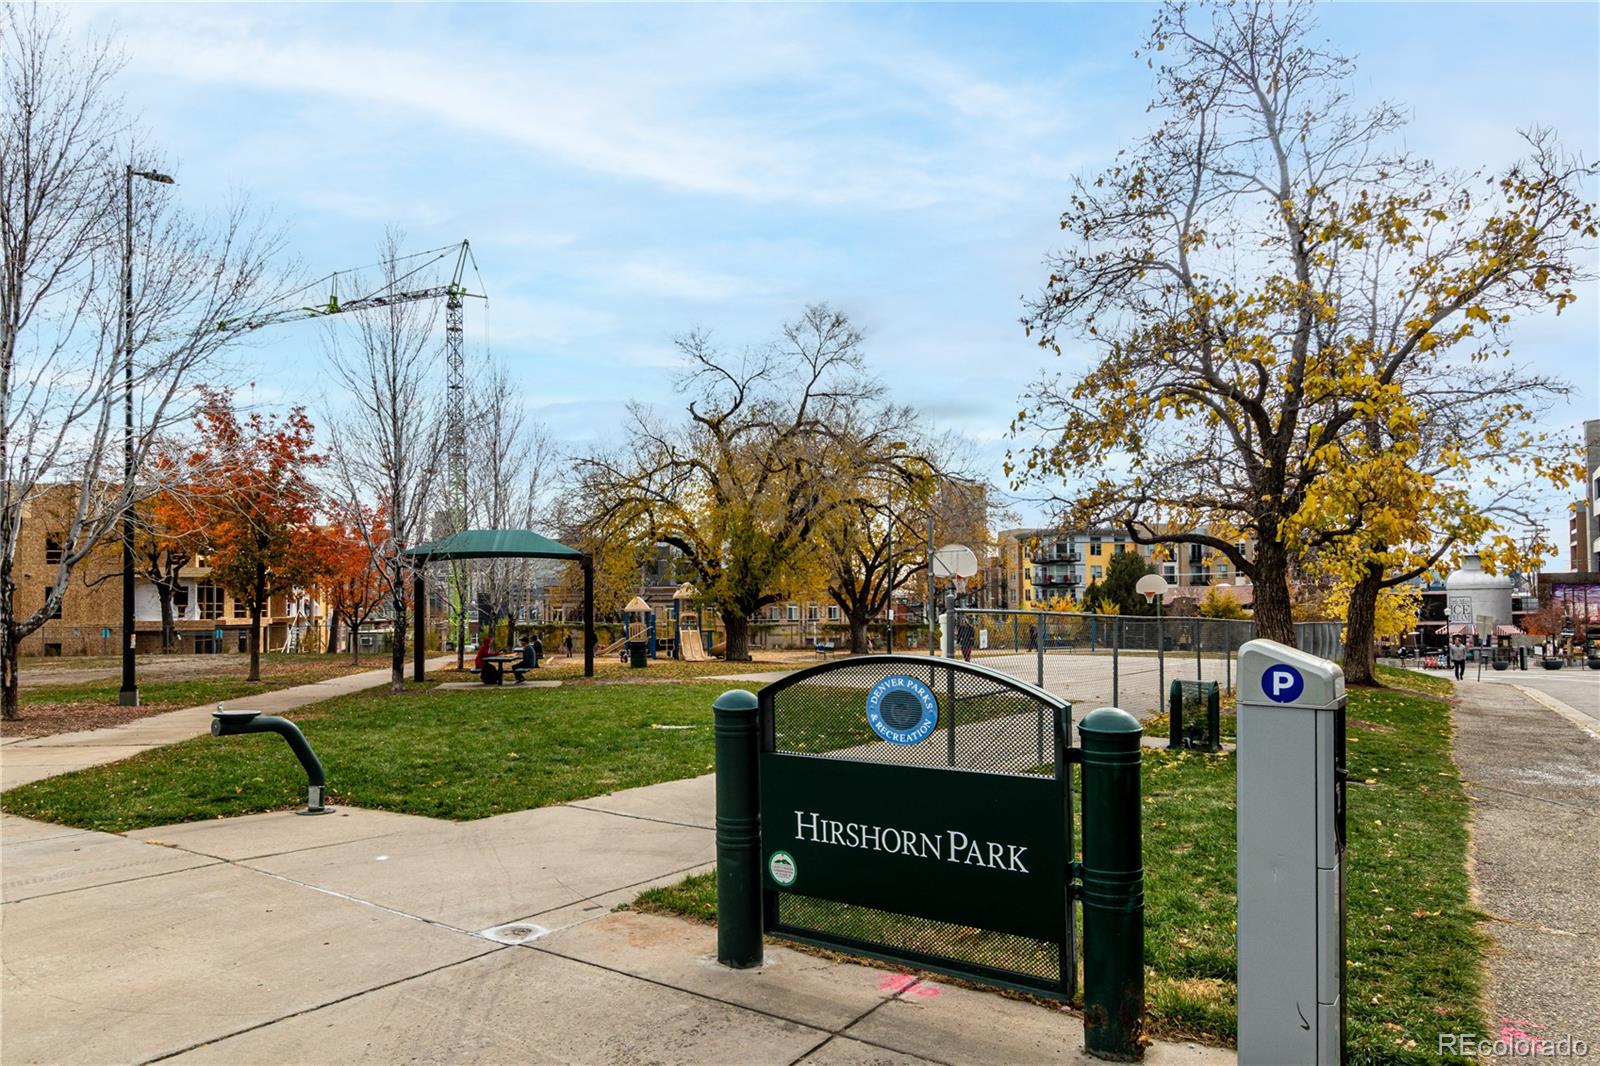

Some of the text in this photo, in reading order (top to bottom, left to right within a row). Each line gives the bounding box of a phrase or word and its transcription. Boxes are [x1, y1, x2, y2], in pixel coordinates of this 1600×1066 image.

[1450, 604, 1471, 615] ICE
[870, 678, 934, 711] DENVER PARKS
[1273, 671, 1295, 696] P
[870, 713, 932, 743] & RECREATION
[794, 810, 1030, 874] HIRSHORN PARK
